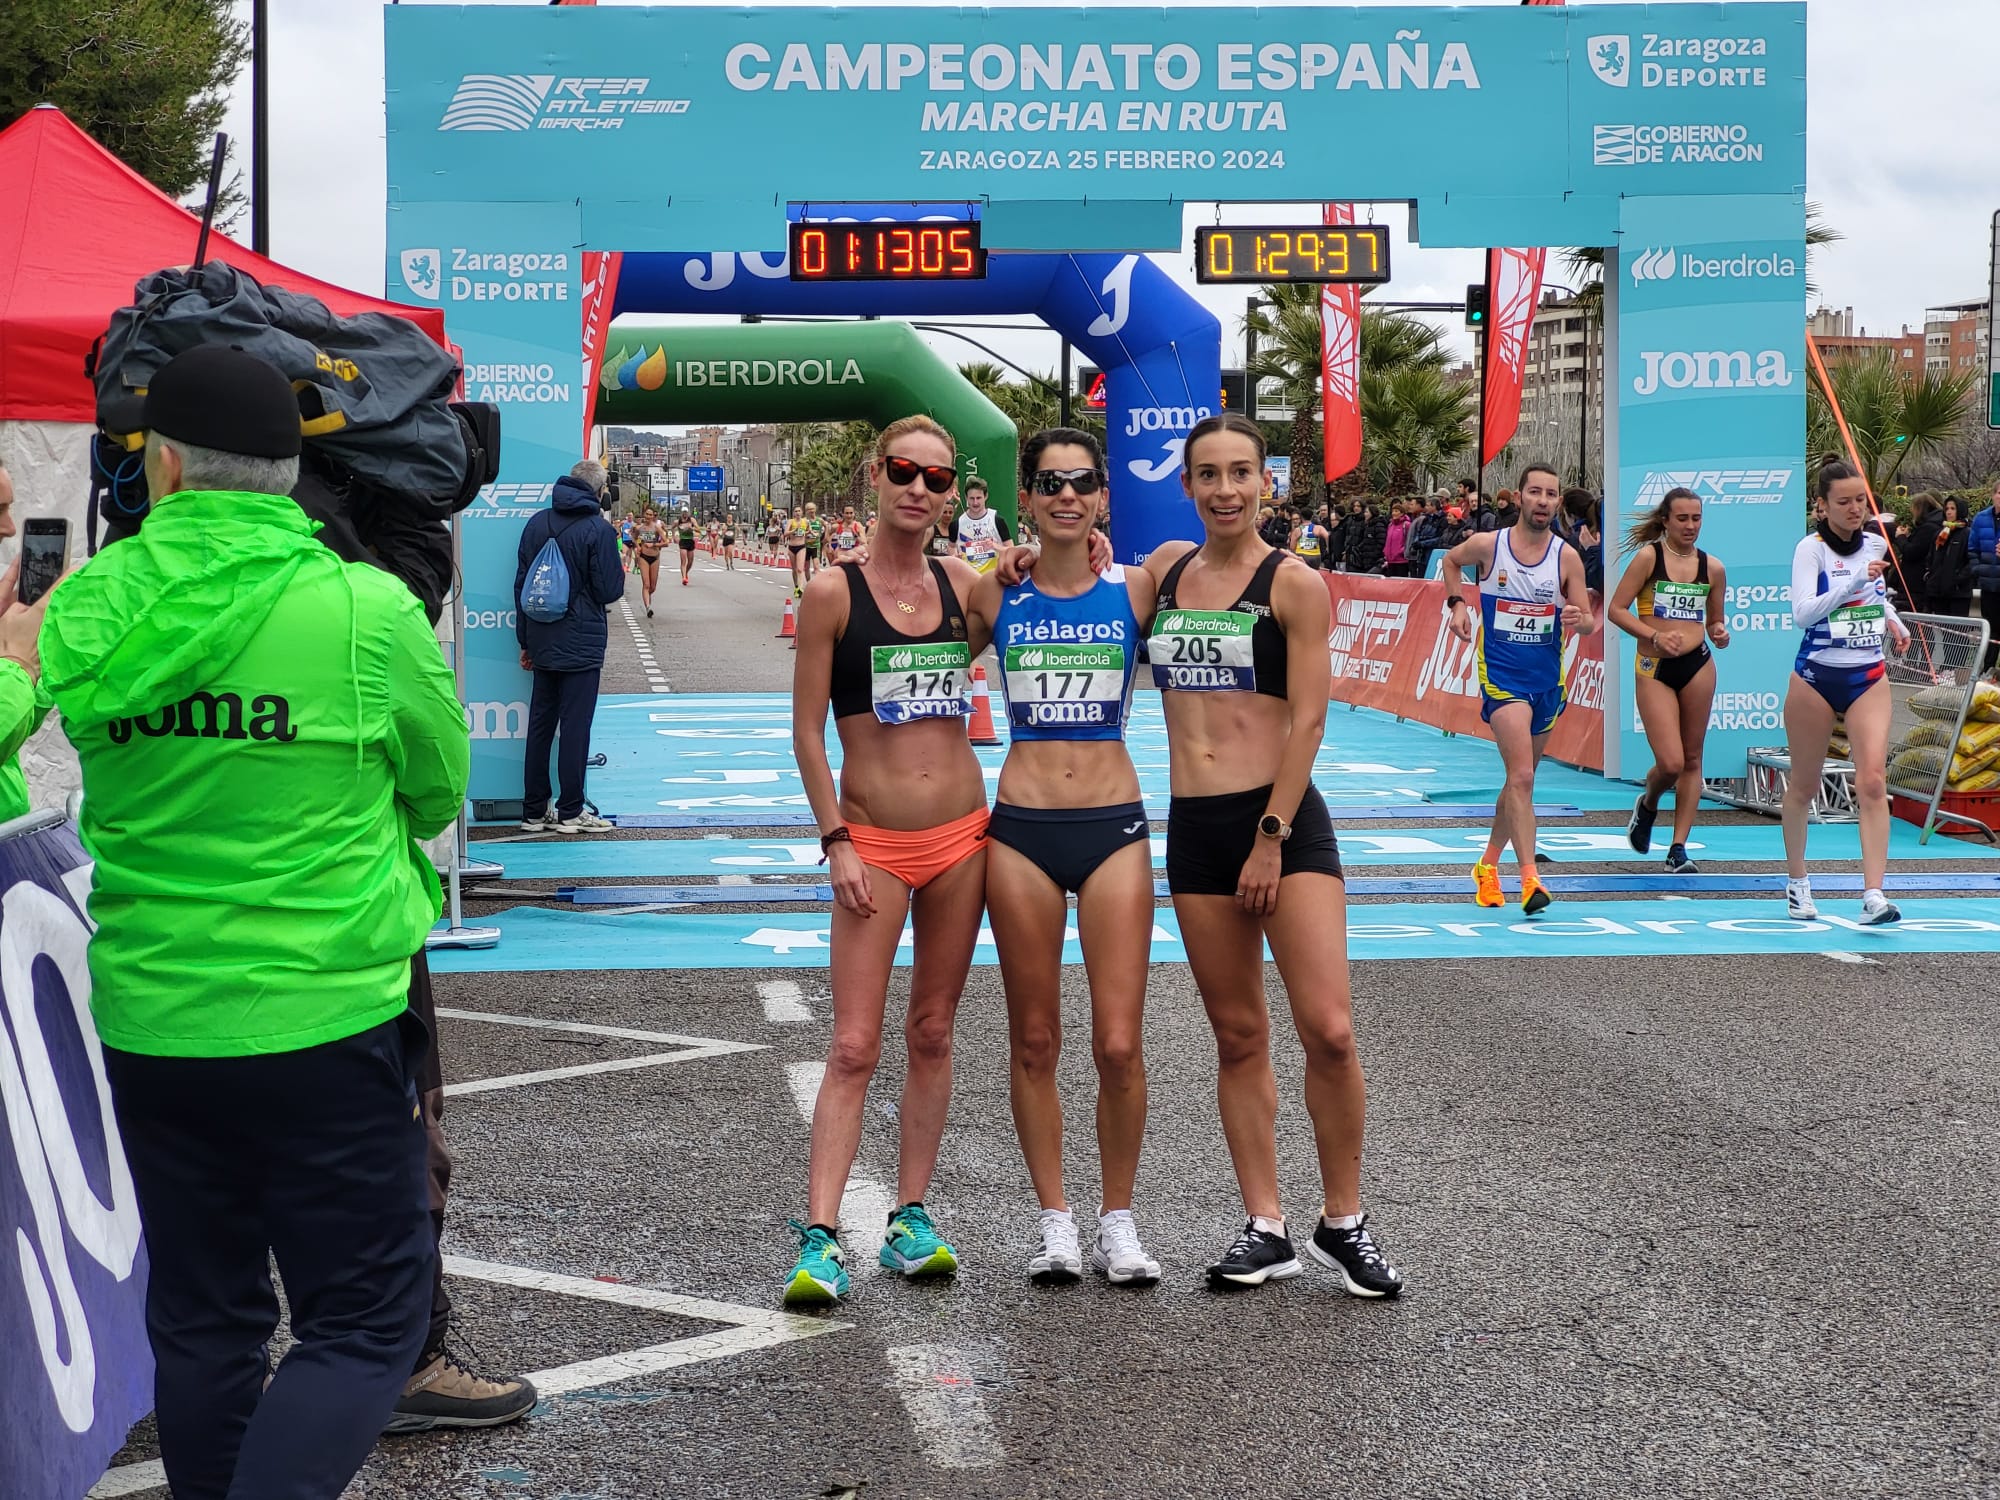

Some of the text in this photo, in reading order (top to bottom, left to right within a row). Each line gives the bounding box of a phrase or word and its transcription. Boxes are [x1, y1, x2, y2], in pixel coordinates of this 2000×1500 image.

[1643, 34, 1766, 60] Zaragoza
[726, 29, 1481, 91] CAMPEONATO ESPAÑA
[1643, 65, 1766, 87] DEPORTE
[552, 78, 650, 97] RFEA
[546, 98, 690, 113] ATLETISMO
[537, 116, 624, 131] MARCHA
[920, 102, 1287, 131] MARCHA EN RUTA
[1635, 125, 1747, 144] GOBIERNO
[920, 150, 1285, 170] ZARAGOZA 25 FEBRERO 2024
[1635, 144, 1763, 163] DE ARAGON
[452, 248, 567, 278] Zaragoza
[1682, 254, 1795, 278] Iberdrola
[452, 276, 568, 300] DEPORTE
[675, 359, 864, 386] IBERDROLA
[1633, 350, 1793, 395] Joma
[479, 384, 569, 402] ARAGON
[1701, 494, 1784, 505] TLETISMO
[1670, 595, 1695, 610] 194
[1725, 585, 1792, 609] agoza
[1184, 617, 1241, 633] Iberdrola
[1514, 617, 1537, 632] 44
[1725, 613, 1792, 631] ORTE
[1847, 620, 1876, 637] 212
[914, 651, 966, 667] Iberdrola
[1046, 651, 1111, 666] Iberdrola
[1171, 636, 1223, 665] 205
[905, 670, 955, 698] 176
[1034, 672, 1094, 700] 177
[1168, 666, 1239, 688] Joma
[897, 700, 961, 721] Joma
[1027, 702, 1105, 725] Joma
